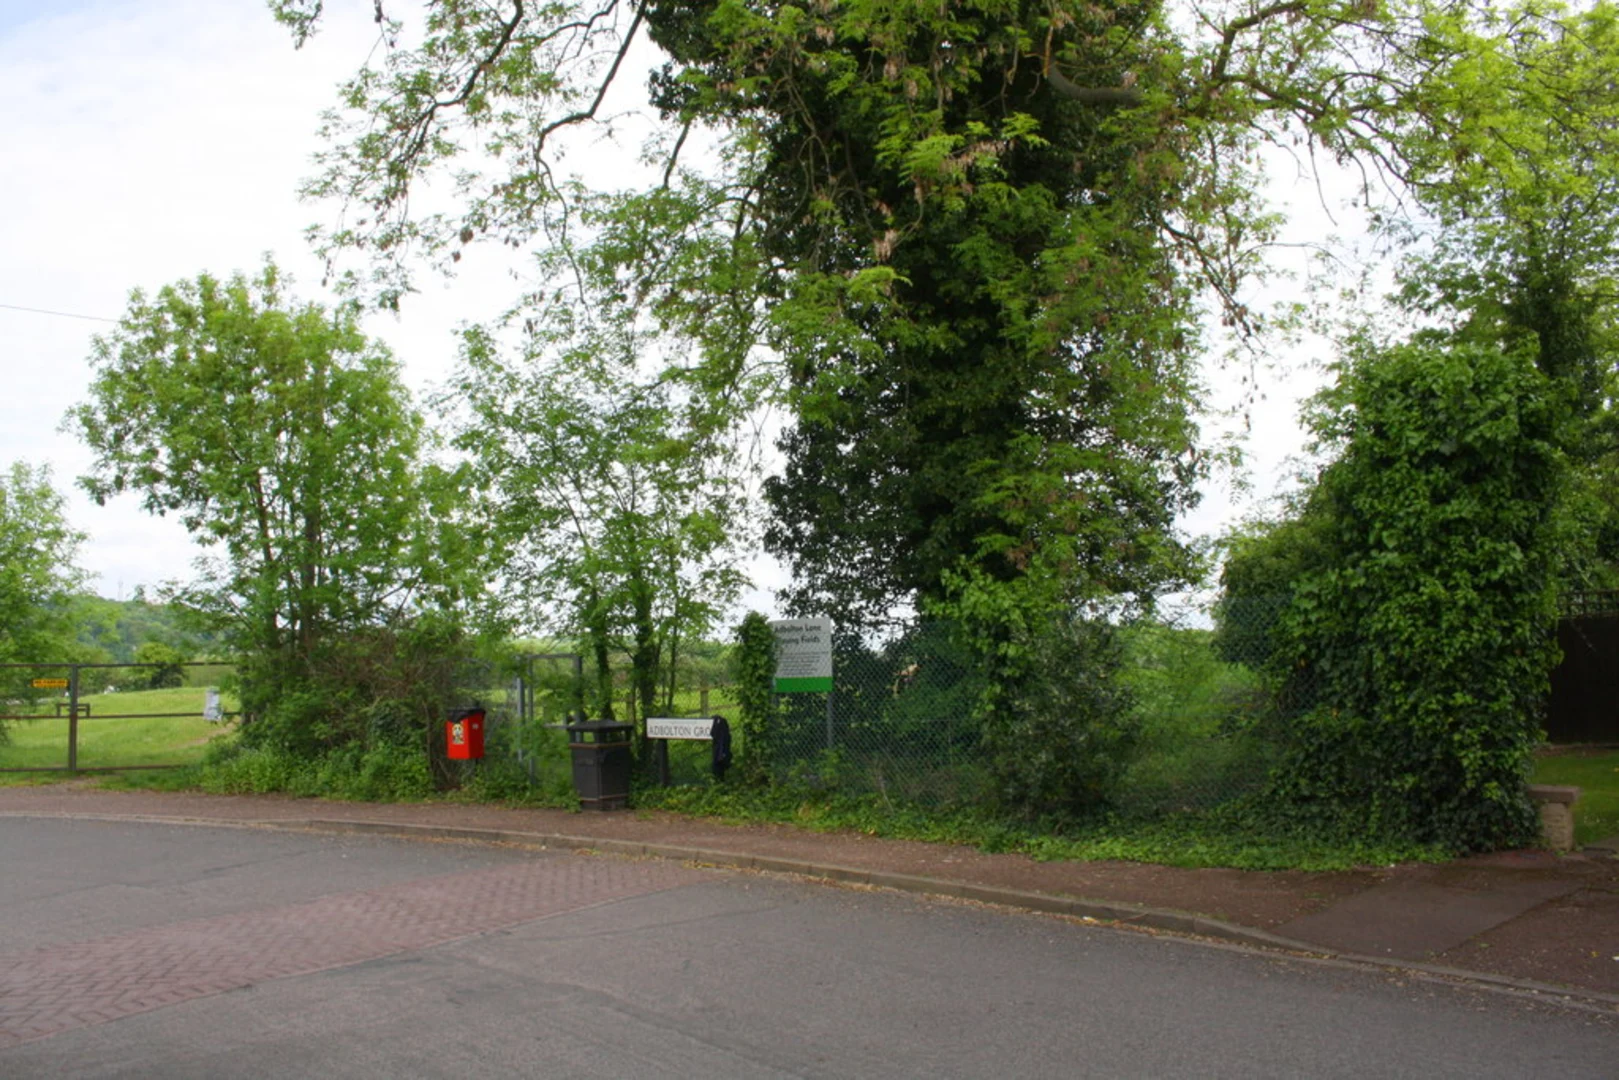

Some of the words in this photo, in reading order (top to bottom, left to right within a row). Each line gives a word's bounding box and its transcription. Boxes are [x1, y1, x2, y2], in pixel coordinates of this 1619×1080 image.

[804, 623, 822, 632] Lane
[649, 725, 692, 736] ADBOLTON
[693, 726, 711, 737] GRO
